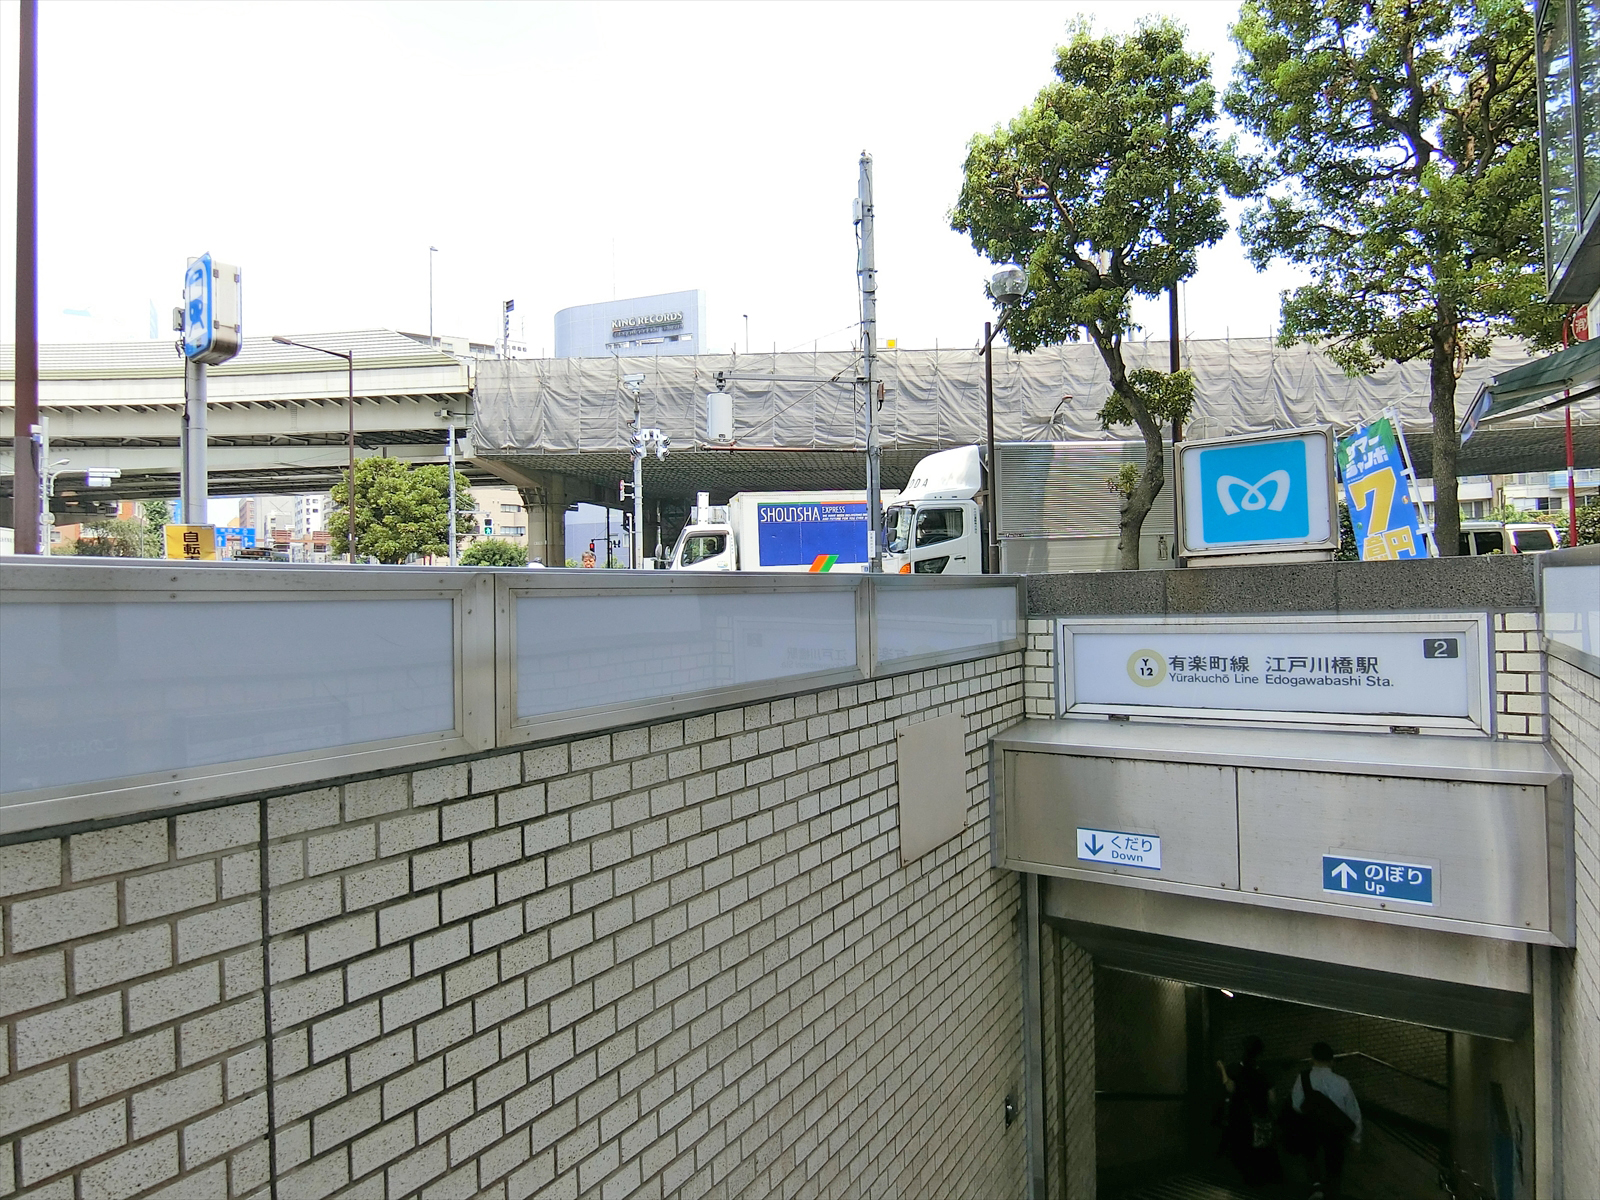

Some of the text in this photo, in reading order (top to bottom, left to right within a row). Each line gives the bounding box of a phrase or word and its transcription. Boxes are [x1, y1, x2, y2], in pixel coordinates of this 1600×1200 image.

[611, 311, 684, 329] KING RECORDS
[1346, 435, 1380, 461] サマー
[1346, 445, 1389, 479] ジャンボ
[183, 531, 200, 560] 自転
[1434, 640, 1448, 657] 2
[1140, 667, 1153, 676] 12
[1142, 658, 1149, 667] Y
[1168, 655, 1379, 675] 有楽町線 江戸川橋駅
[1168, 672, 1394, 687] Yūrakuchō Line Edogawabashi Sta.
[1111, 835, 1152, 853] くだり
[1111, 850, 1143, 862] Down
[1364, 864, 1423, 885] のぼり
[1365, 880, 1385, 895] Up
